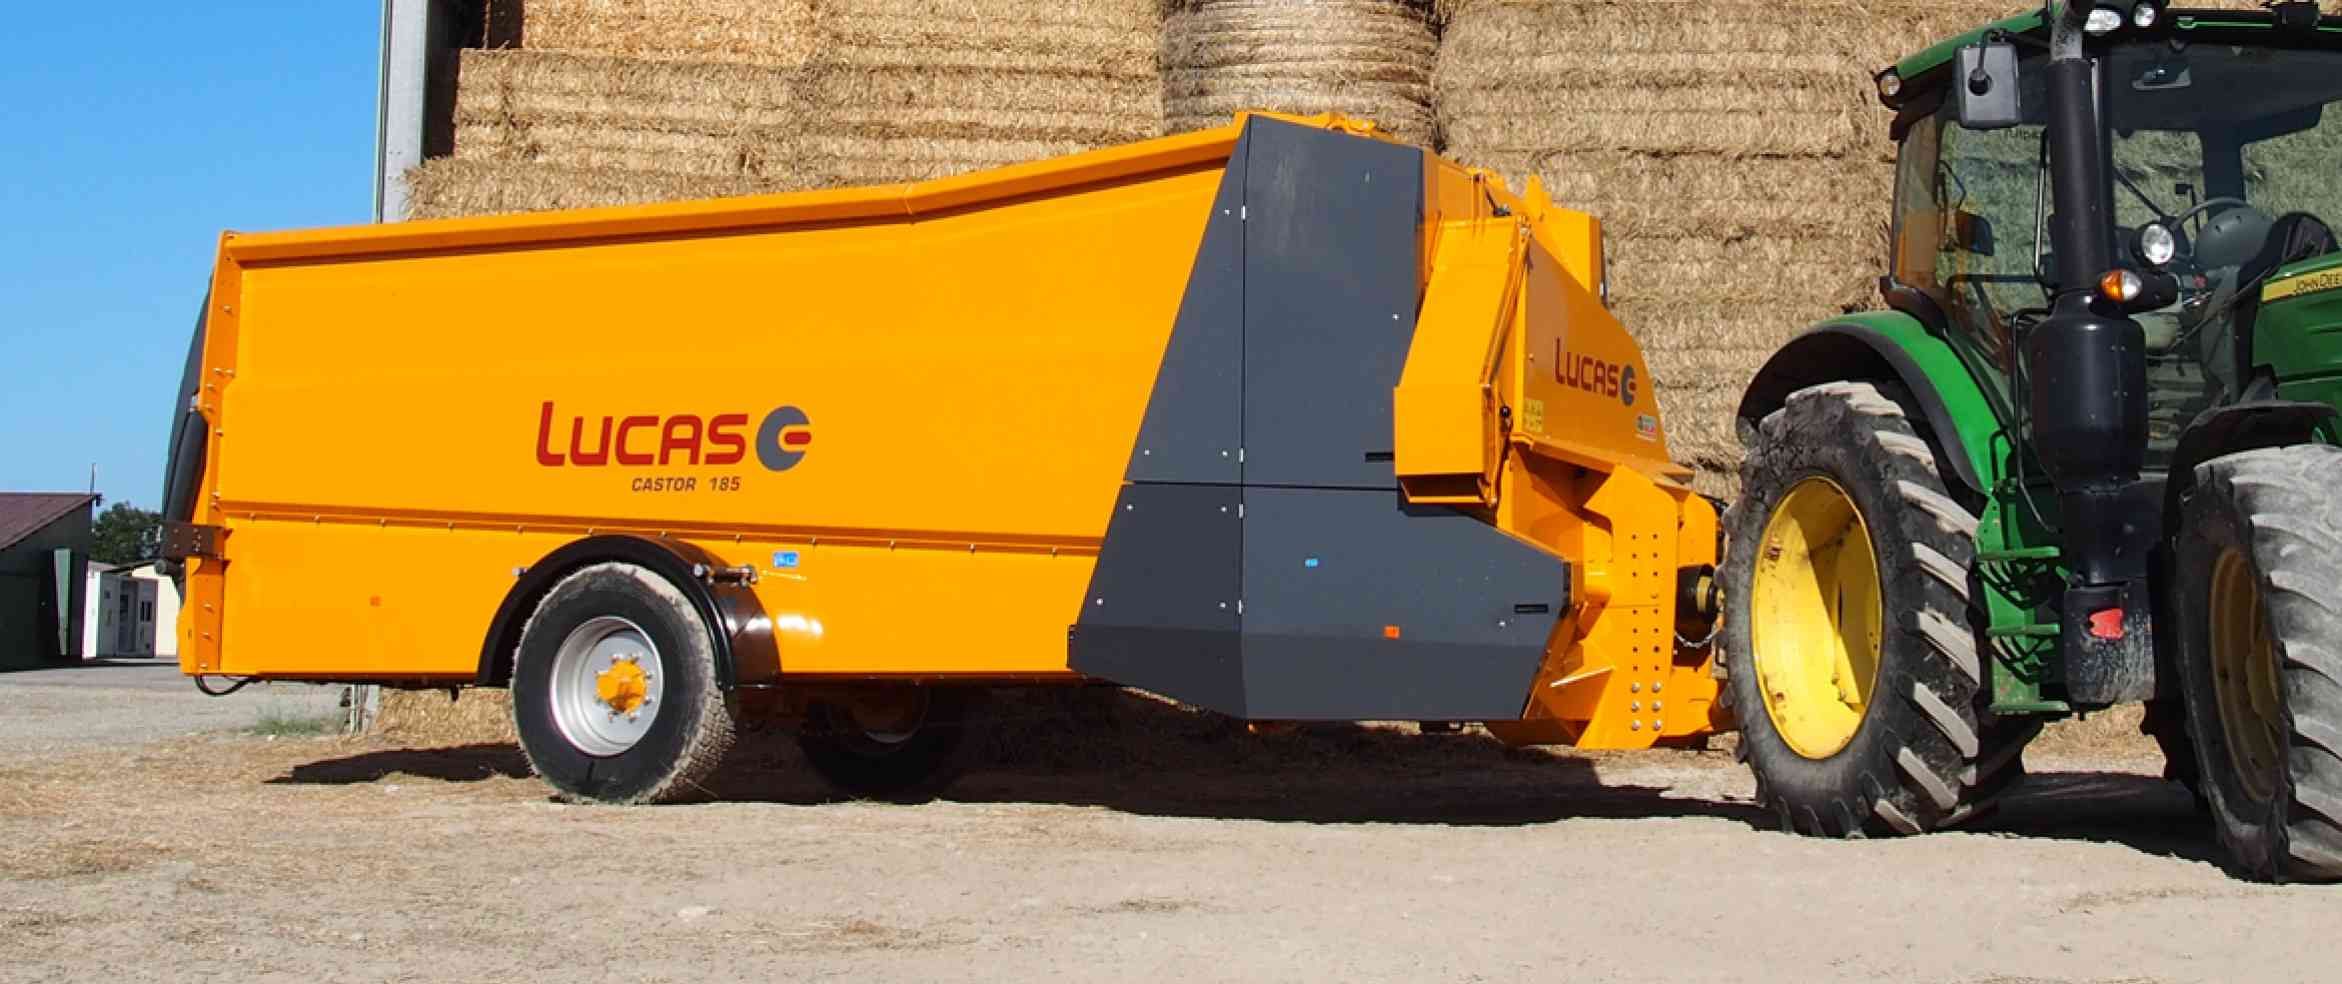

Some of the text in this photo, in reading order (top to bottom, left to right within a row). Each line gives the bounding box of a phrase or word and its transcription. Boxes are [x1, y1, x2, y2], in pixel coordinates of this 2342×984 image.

[1554, 336, 1619, 398] LUCAS
[536, 400, 749, 467] LUCAS
[632, 476, 741, 492] CASTOR 185
